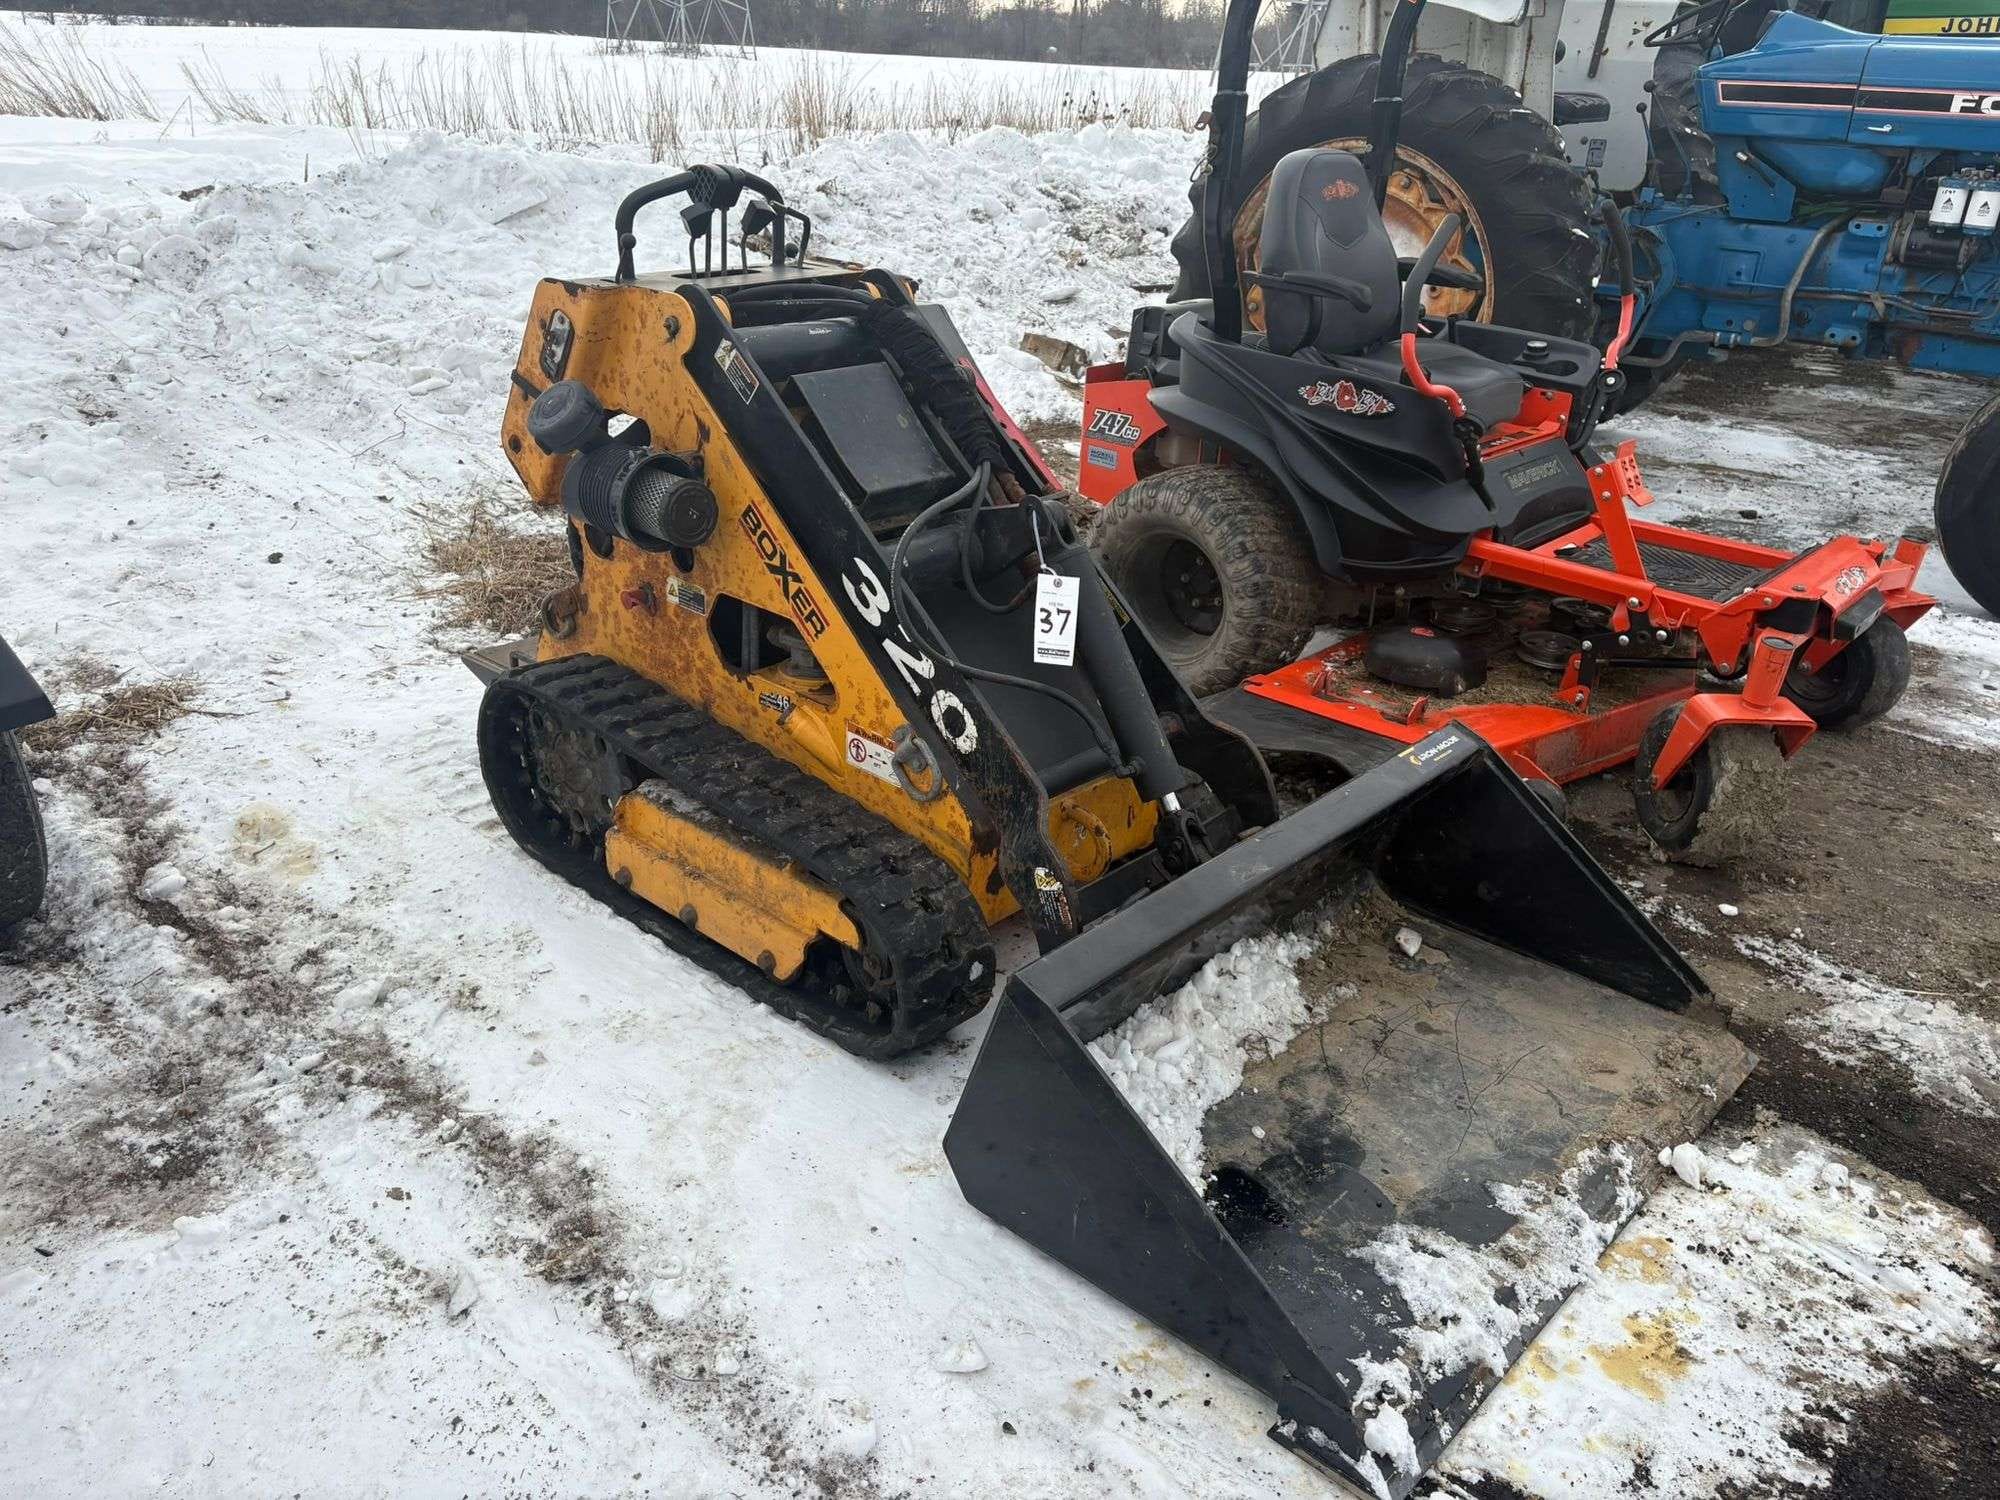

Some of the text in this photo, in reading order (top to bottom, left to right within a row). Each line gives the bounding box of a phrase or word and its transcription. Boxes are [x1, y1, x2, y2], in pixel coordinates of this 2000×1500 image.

[740, 503, 828, 641] BOXER
[1039, 607, 1072, 635] 37
[842, 557, 979, 755] 320
